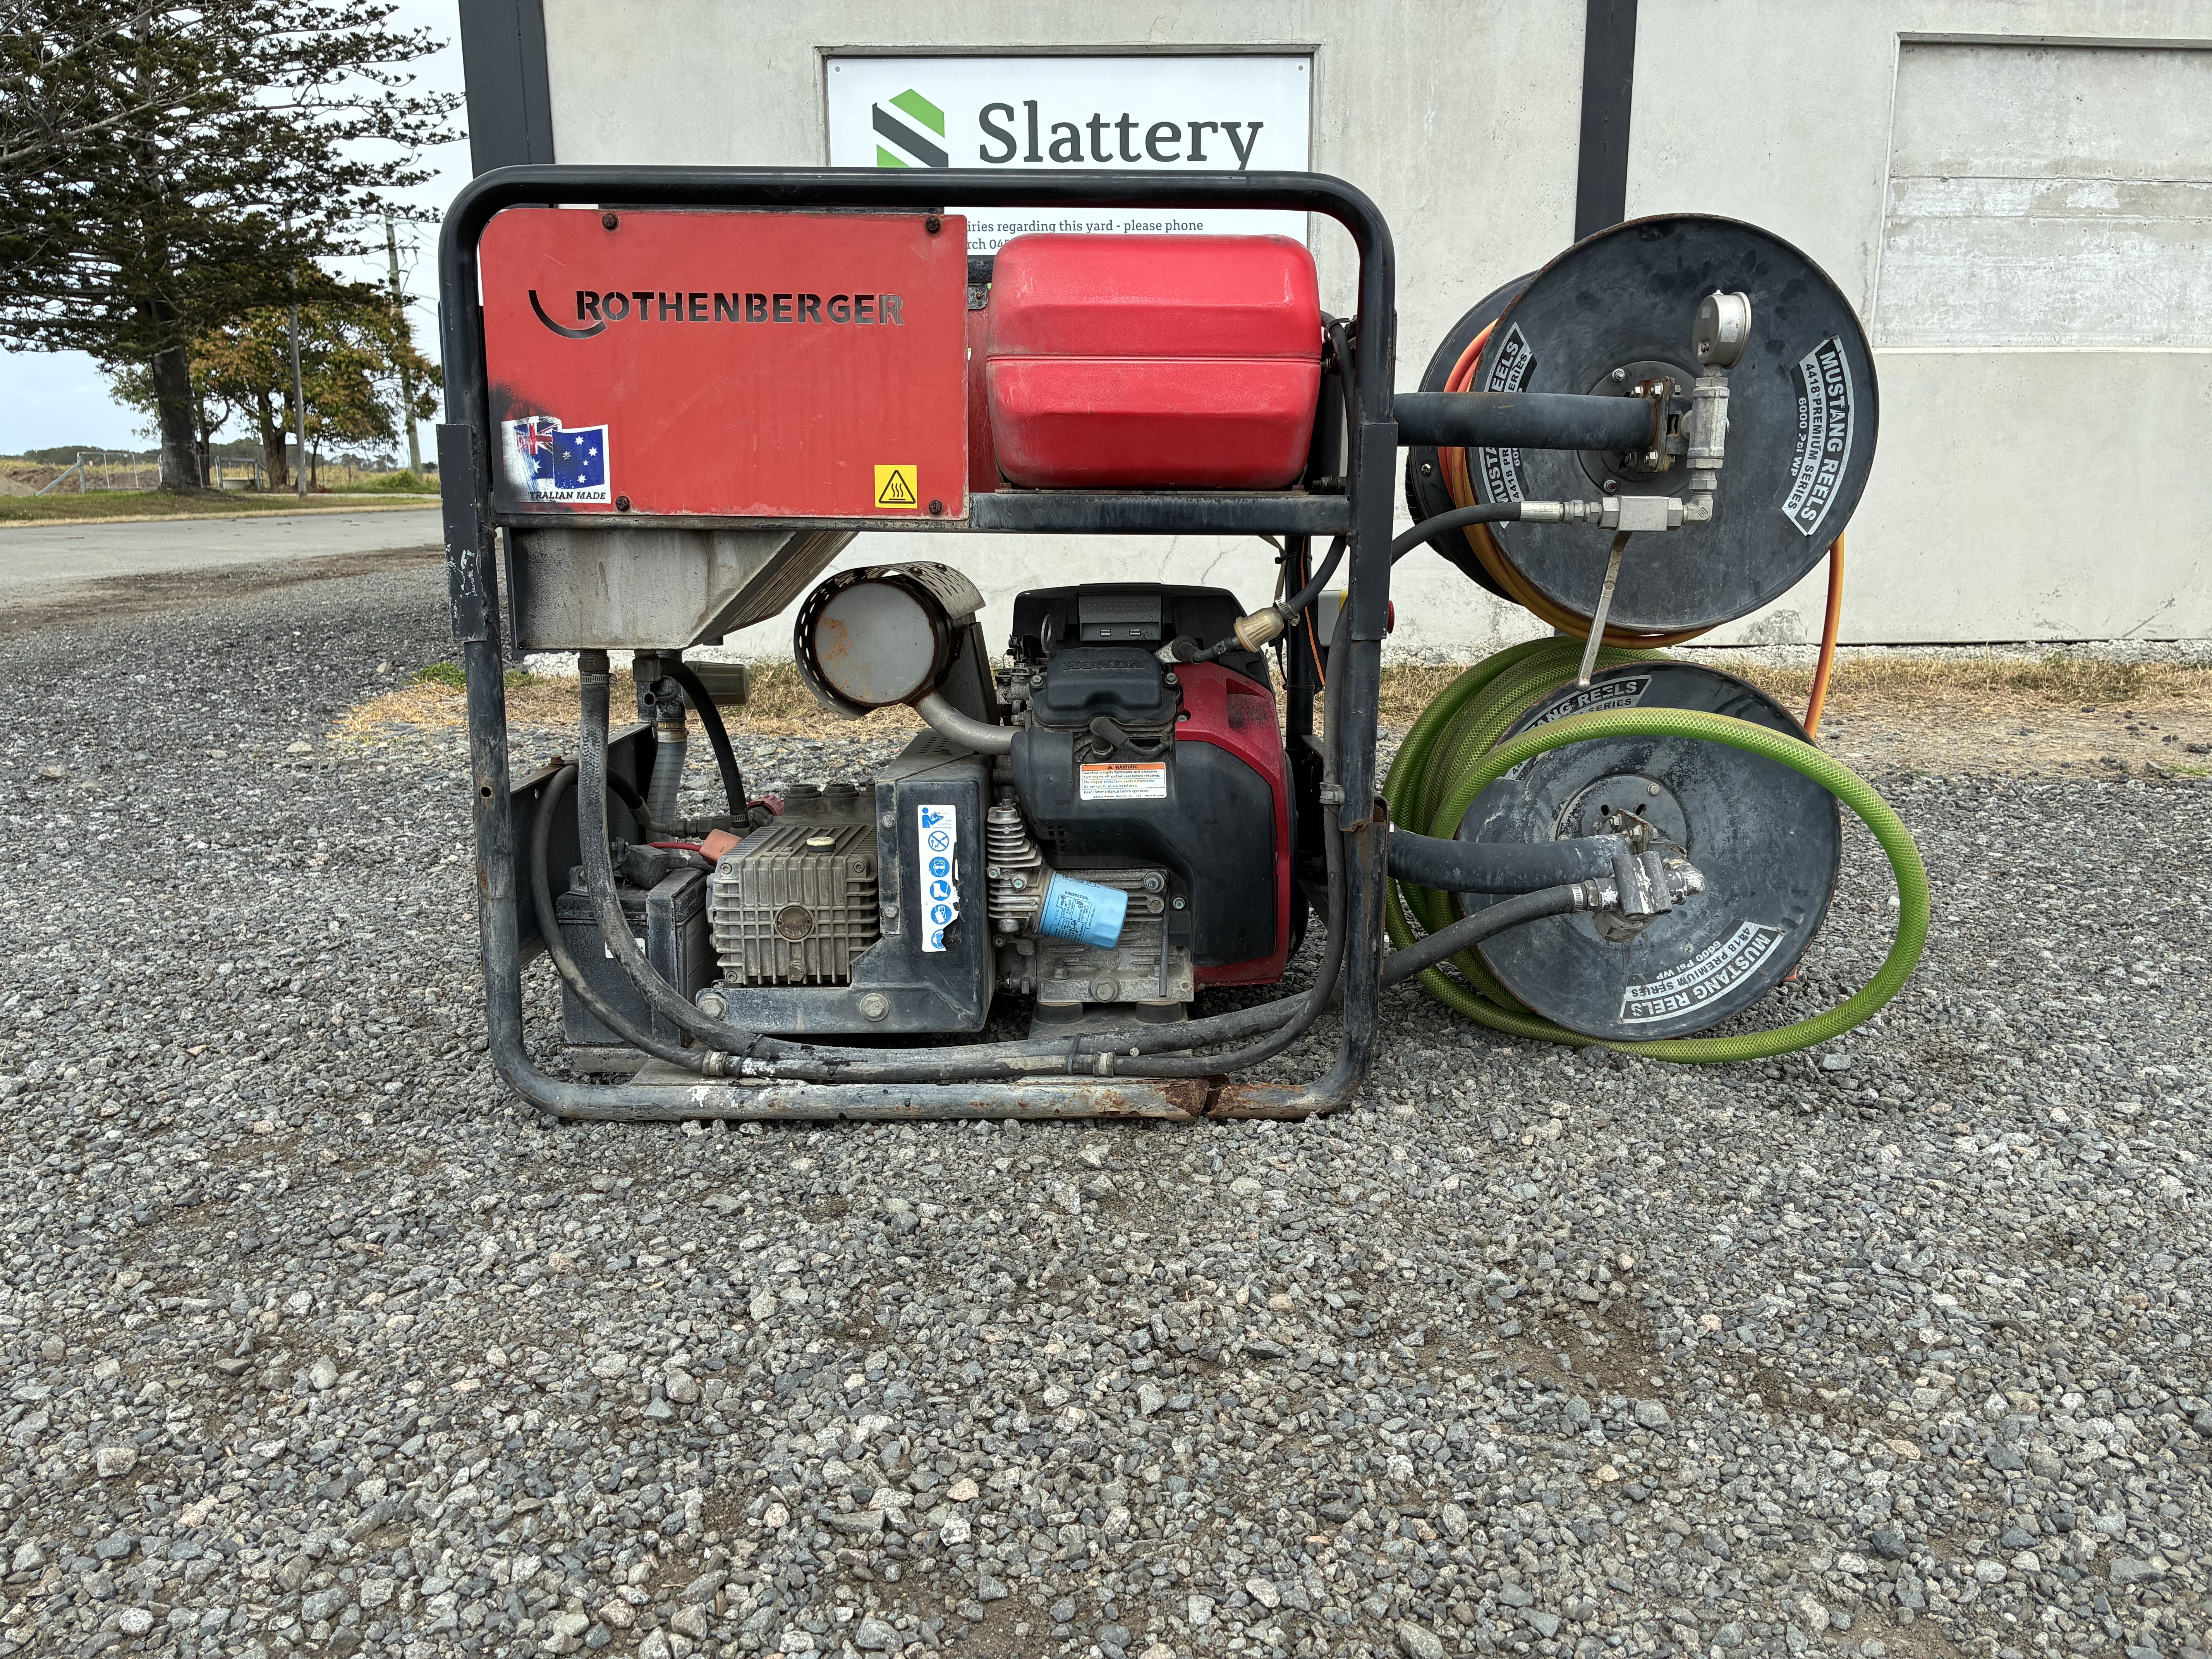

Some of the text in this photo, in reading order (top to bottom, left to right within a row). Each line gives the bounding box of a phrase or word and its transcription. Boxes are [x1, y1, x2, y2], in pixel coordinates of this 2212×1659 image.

[979, 100, 1264, 170] Slattery
[997, 220, 1056, 234] regarding
[1059, 220, 1083, 232] this
[1085, 220, 1113, 233] yard
[1123, 220, 1162, 233] please
[1165, 219, 1203, 233] phone
[576, 290, 905, 326] ROTHENBERGER
[1508, 354, 1527, 391] ERIES
[1799, 397, 1807, 429] 6000
[1788, 364, 1823, 509] 4418 PREMIUM SERIES
[1801, 351, 1845, 520] MUSTANG REELS
[576, 491, 606, 500] MADE
[1506, 470, 1519, 498] 4418
[1062, 660, 1145, 670] HONDA
[1577, 682, 1637, 707] REELS
[1065, 891, 1089, 900] HONDA
[1696, 941, 1721, 962] 6000
[1631, 933, 1771, 1017] MUSTANG REELS
[1656, 969, 1674, 981] WP
[1677, 952, 1729, 986] PREMIUM
[1632, 981, 1674, 997] SERIES
